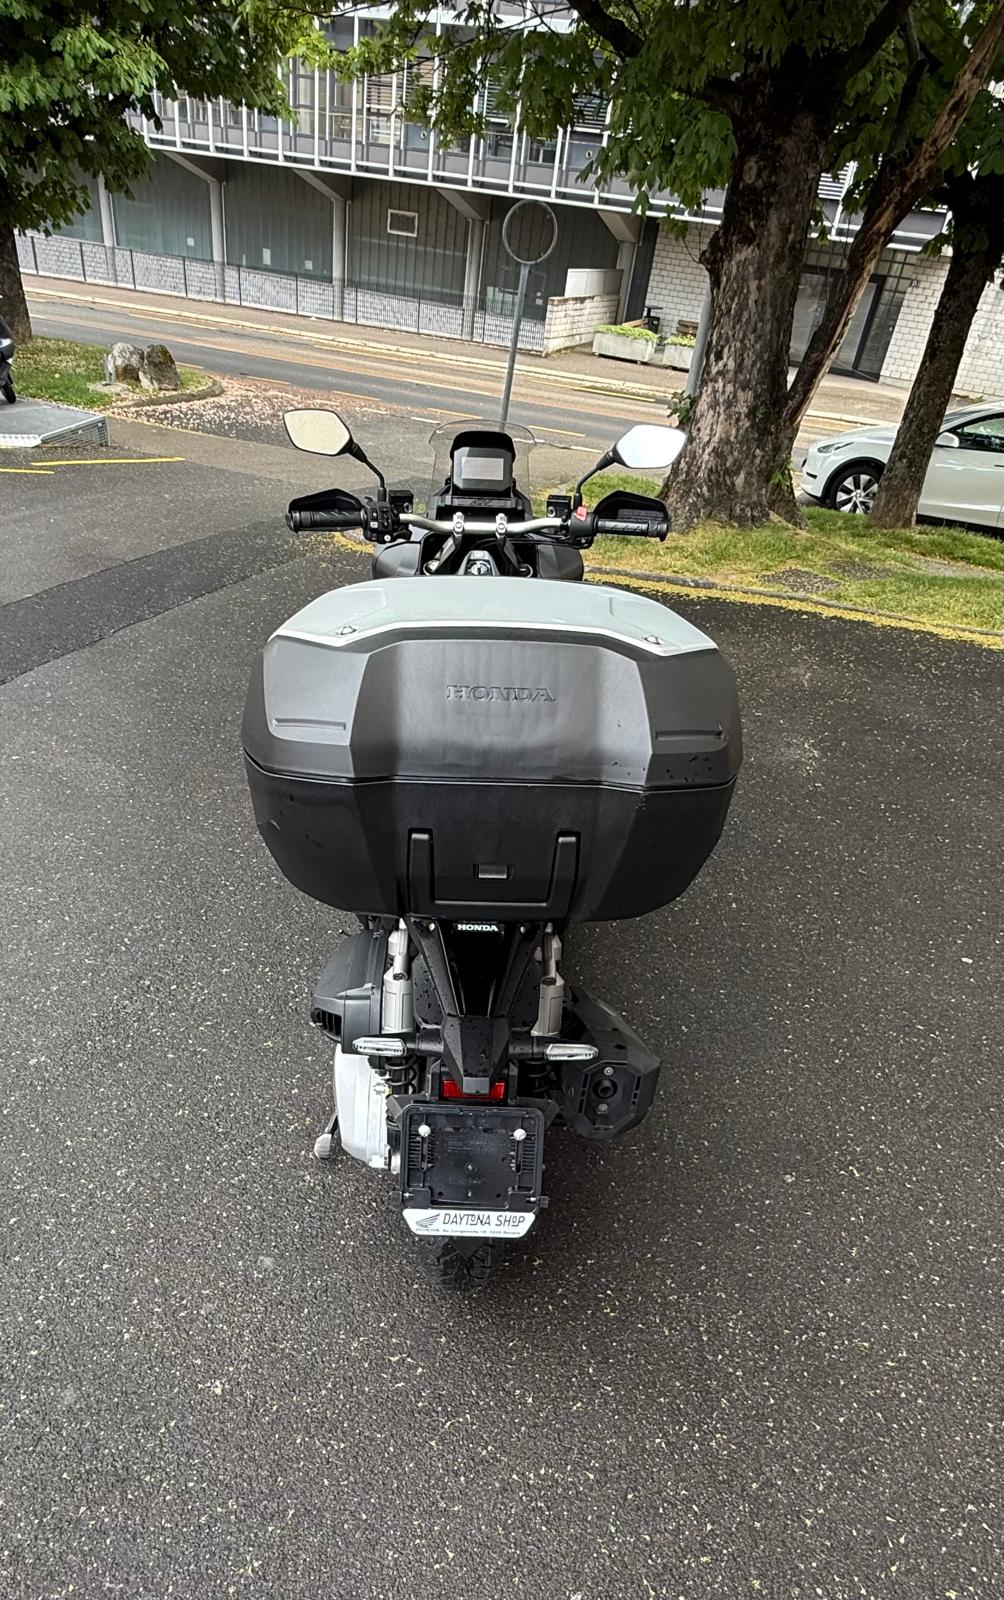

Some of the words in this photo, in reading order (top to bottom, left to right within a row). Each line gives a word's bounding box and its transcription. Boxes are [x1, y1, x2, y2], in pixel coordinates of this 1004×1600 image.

[447, 685, 556, 702] HONDA
[457, 924, 499, 932] HONDA
[443, 1213, 491, 1226] DAYTONA
[495, 1214, 526, 1227] SHOP
